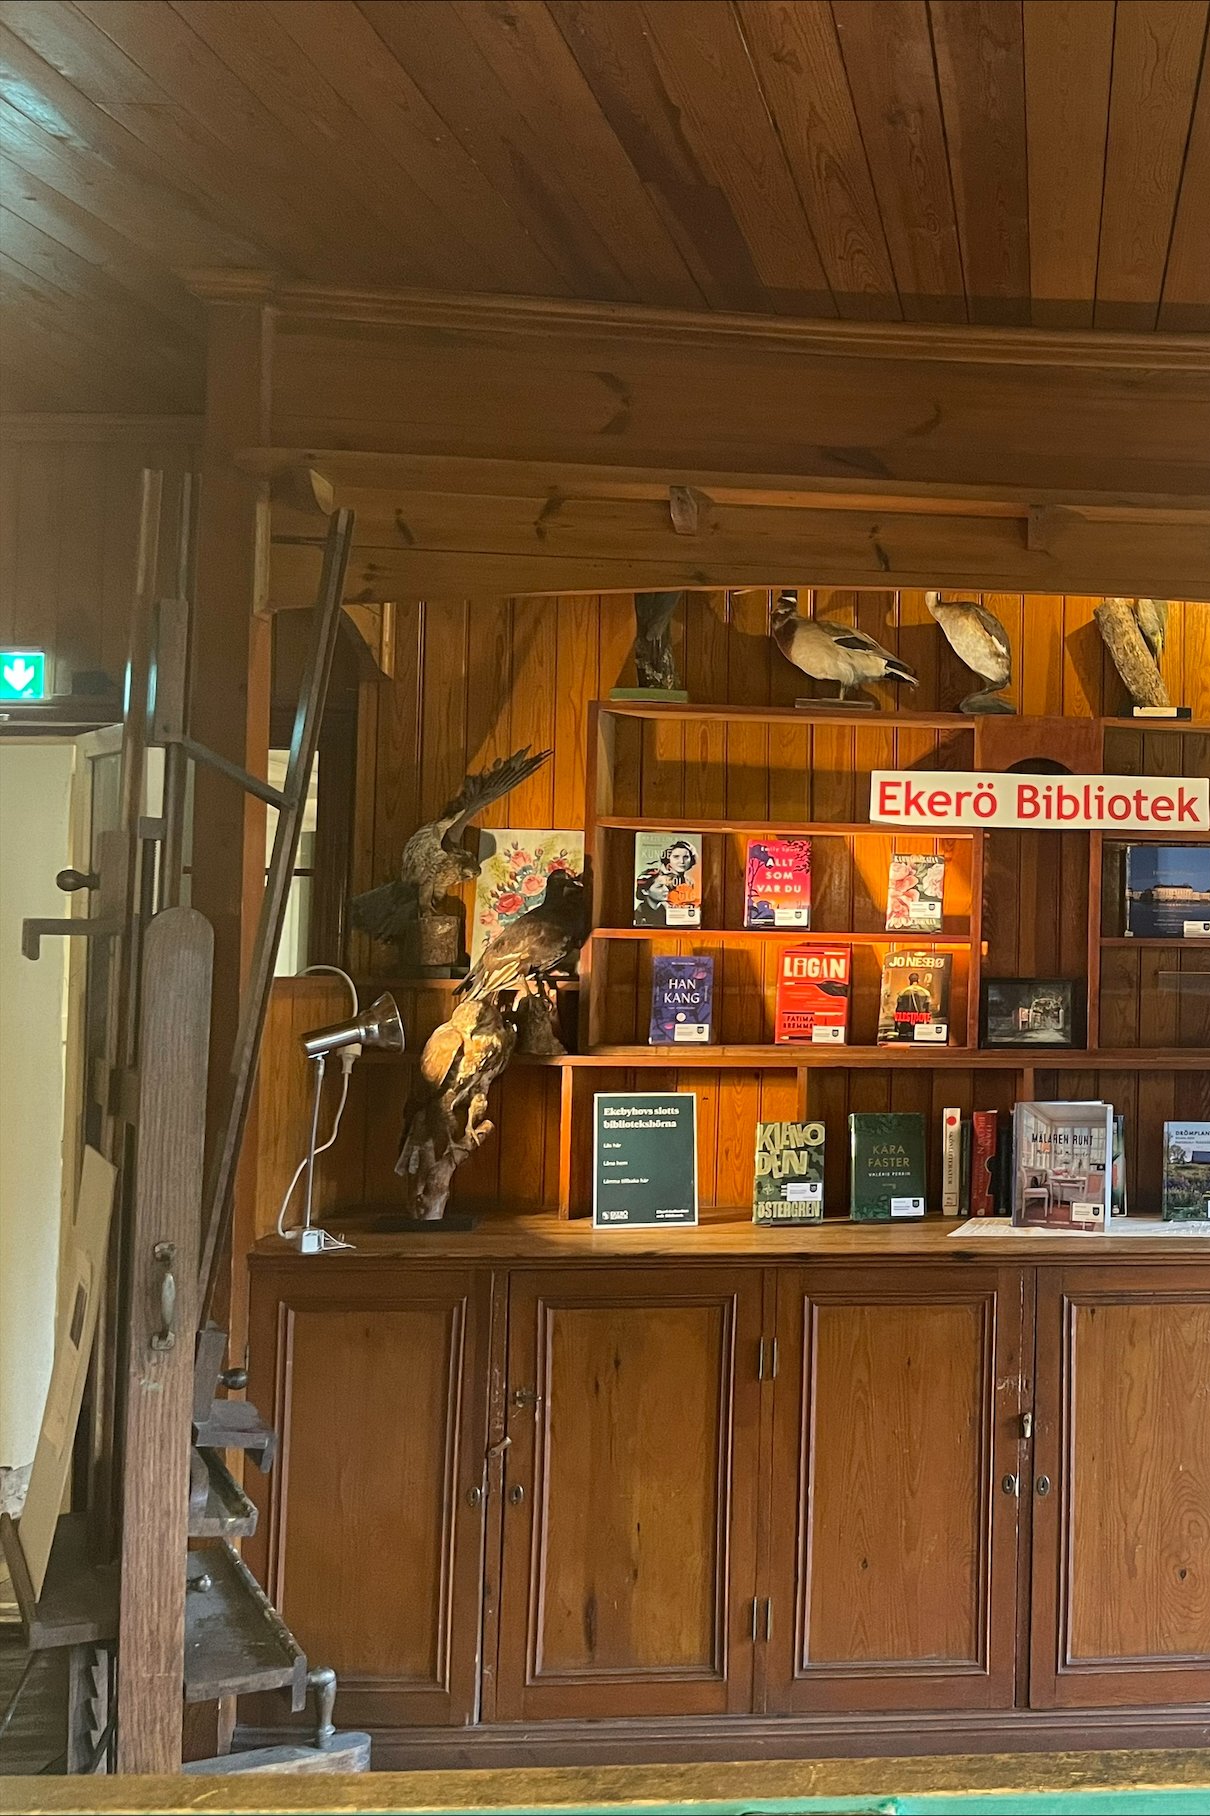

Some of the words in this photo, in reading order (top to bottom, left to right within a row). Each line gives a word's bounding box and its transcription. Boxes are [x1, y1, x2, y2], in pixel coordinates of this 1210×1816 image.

[878, 780, 998, 818] Ekerö
[1016, 783, 1201, 823] Bibliotek
[765, 858, 794, 867] ALLT
[765, 871, 794, 880] SOM
[756, 884, 781, 893] VAR
[784, 884, 802, 893] DU
[888, 956, 905, 968] JO
[905, 956, 945, 968] NESBØ
[668, 978, 696, 990] HAN
[664, 992, 700, 1004] KANG
[603, 1106, 653, 1117] Ekebyhovs
[654, 1106, 680, 1116] slotts
[603, 1119, 677, 1129] bibliotekshörna
[1072, 1134, 1094, 1146] RUNT
[872, 1142, 906, 1155] KÄRA
[756, 1149, 809, 1179] DEN
[867, 1157, 911, 1168] FASTER
[757, 1200, 821, 1218] ÖSTERGREN
